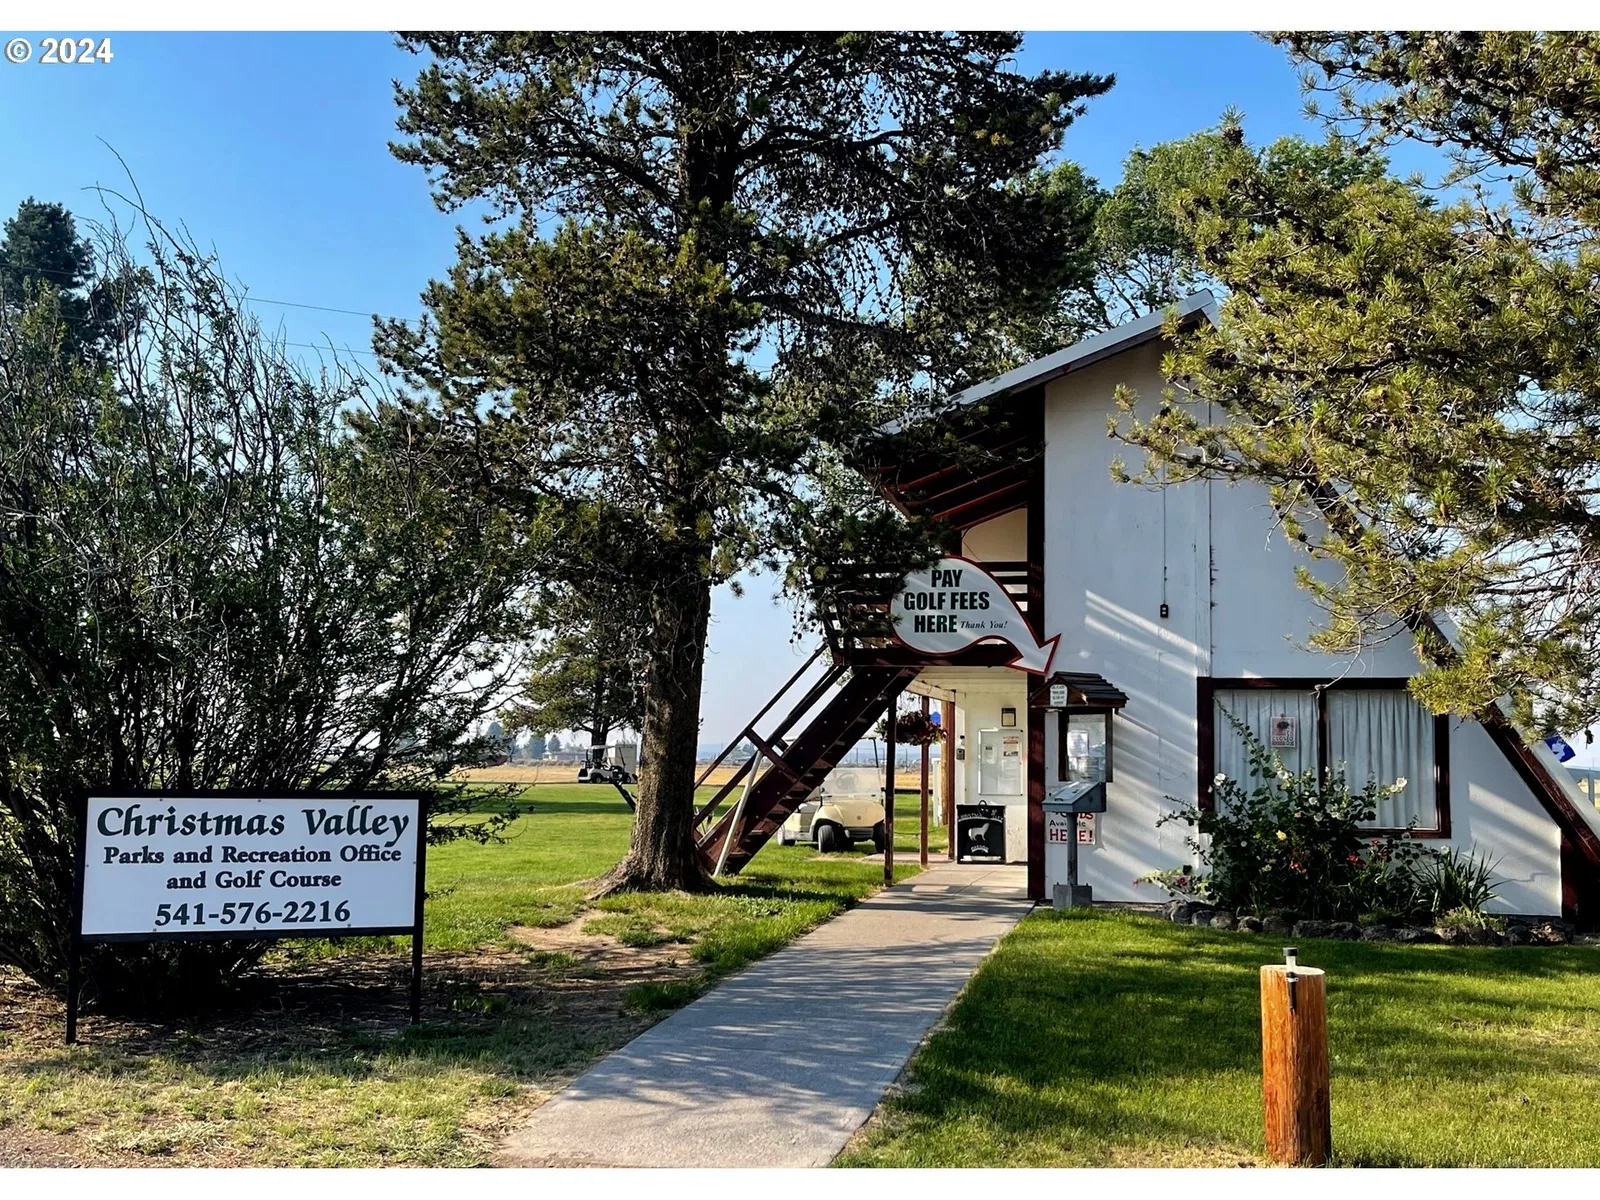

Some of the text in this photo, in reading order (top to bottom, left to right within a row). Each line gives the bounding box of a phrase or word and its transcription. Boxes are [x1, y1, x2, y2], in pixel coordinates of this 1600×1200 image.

[931, 569, 963, 588] PAY
[903, 591, 990, 611] GOLF FEES
[914, 615, 1008, 633] HERE Thank You!
[97, 804, 409, 847] Christmas Valley
[1050, 828, 1093, 842] HEE!
[103, 844, 402, 864] Parks and Recreation Office
[166, 869, 342, 889] and Golf Course
[154, 899, 351, 926] 541-576-2216
